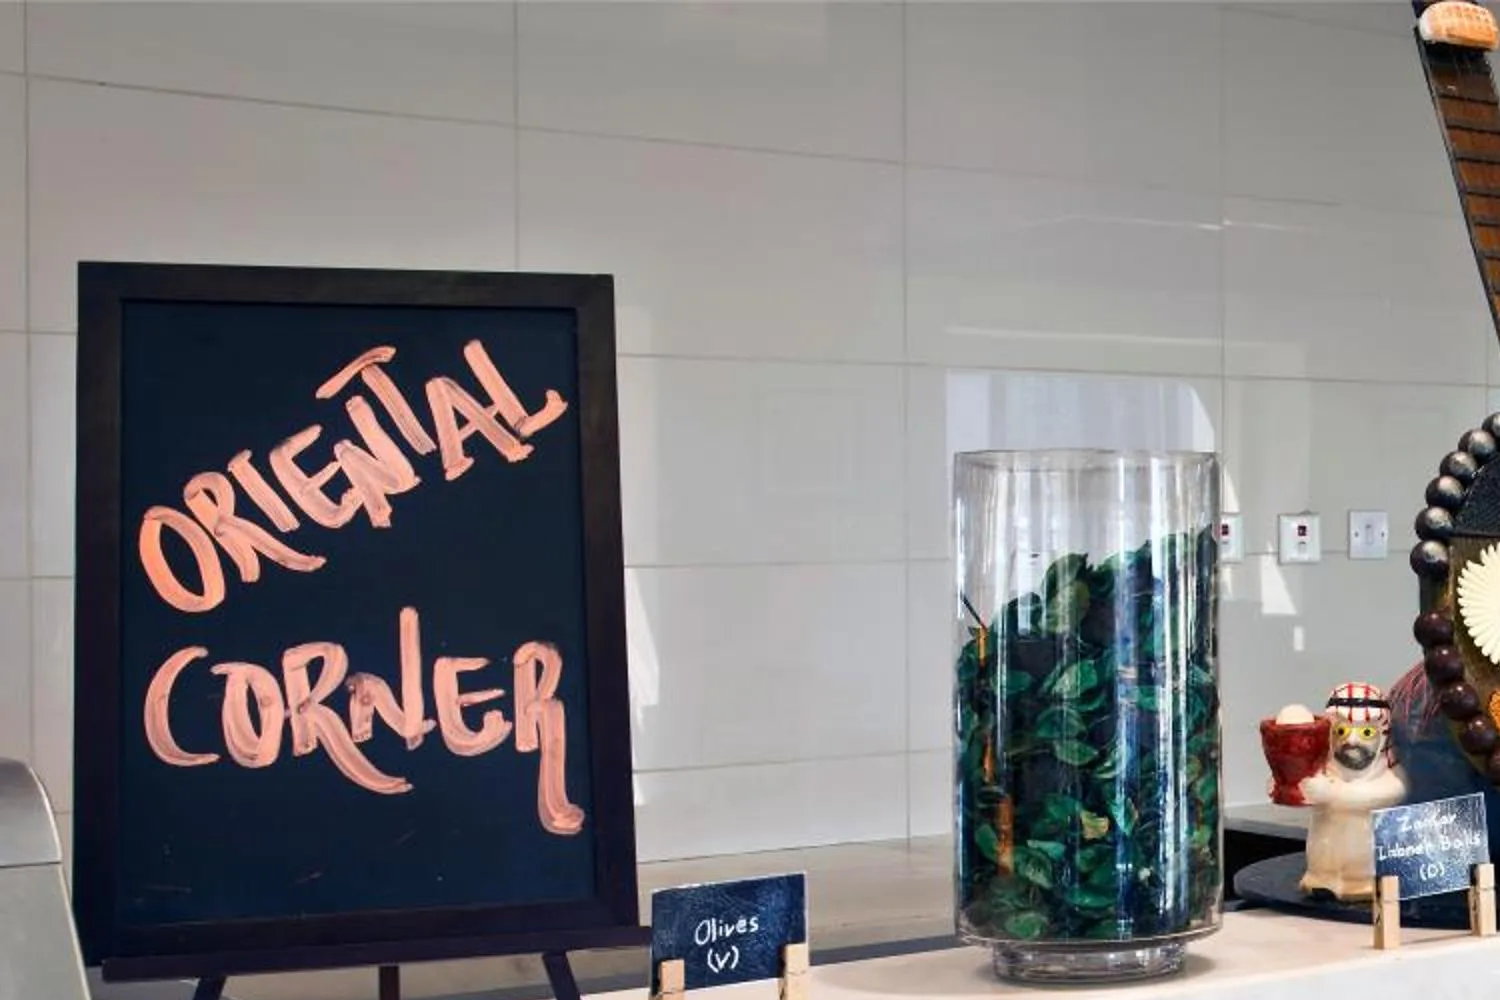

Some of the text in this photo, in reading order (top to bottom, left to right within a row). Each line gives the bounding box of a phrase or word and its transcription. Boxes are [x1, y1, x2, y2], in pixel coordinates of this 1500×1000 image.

[139, 340, 567, 612] ORIENTAL
[144, 606, 584, 834] CORNER
[694, 916, 759, 945] Olives
